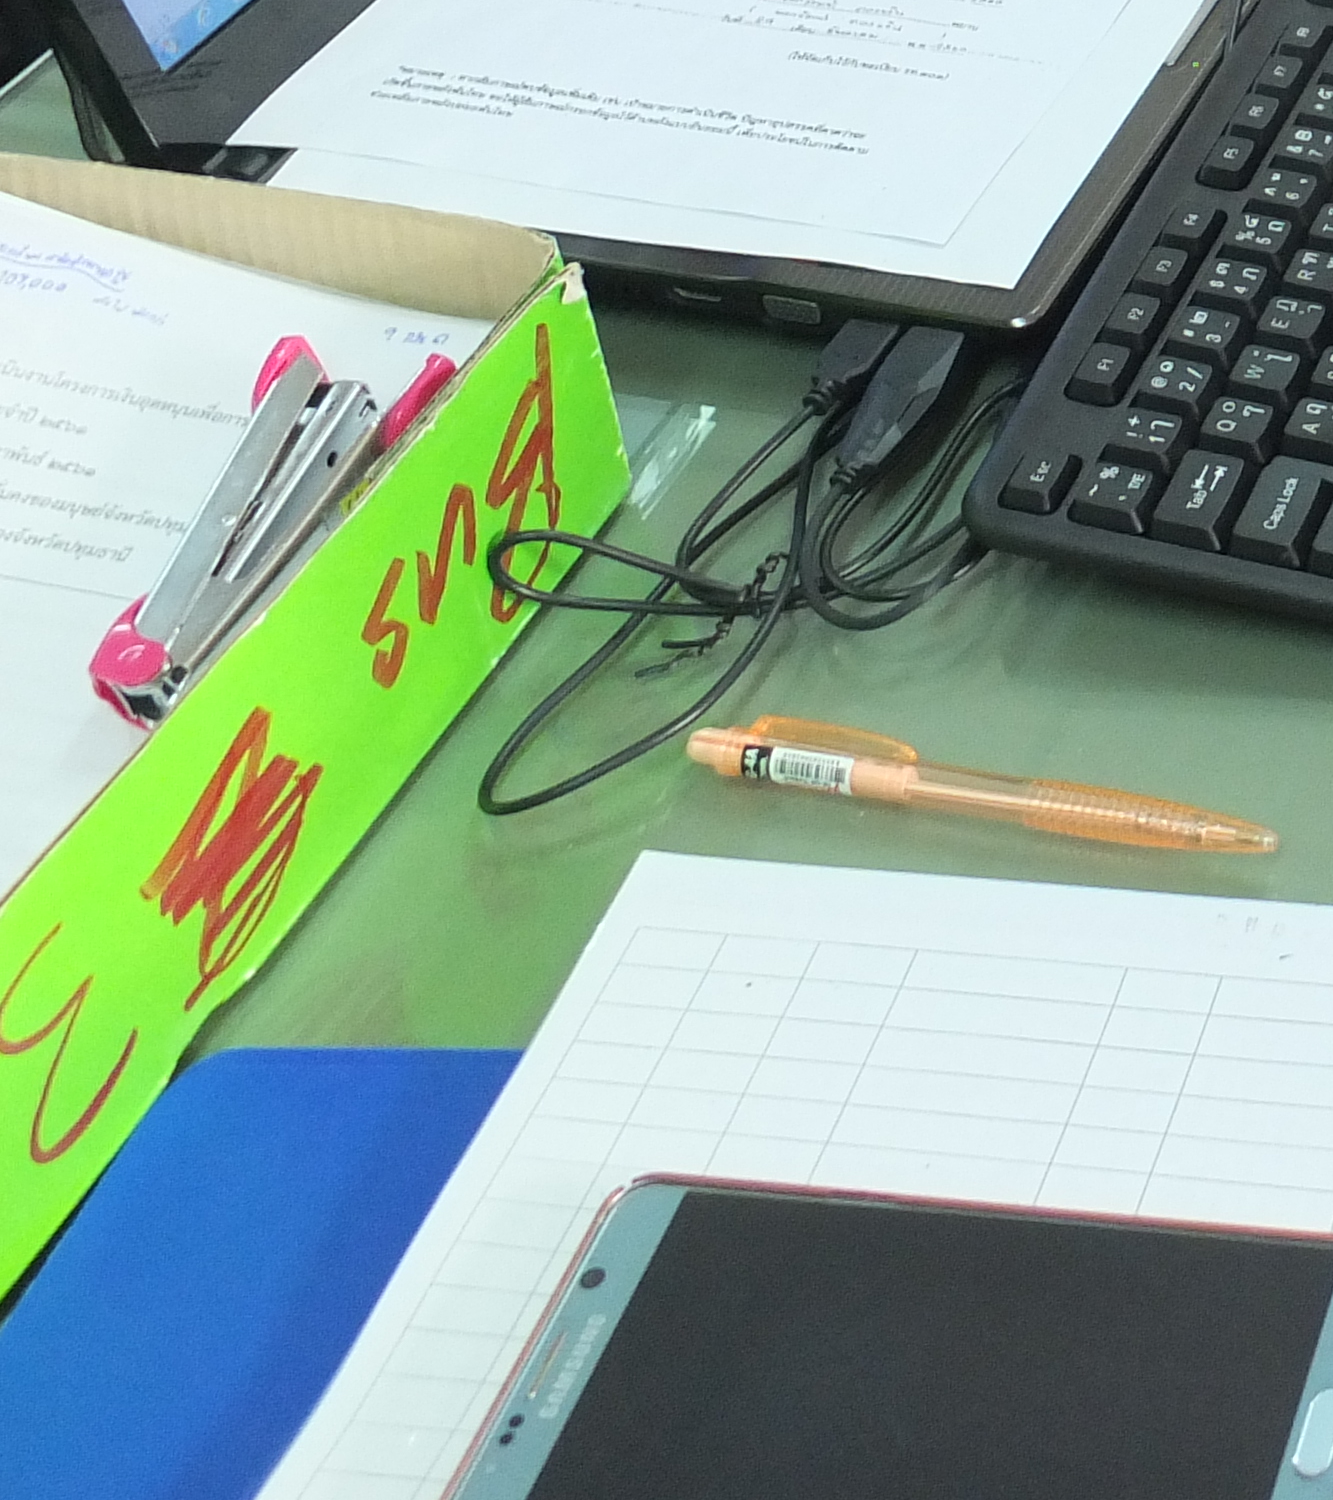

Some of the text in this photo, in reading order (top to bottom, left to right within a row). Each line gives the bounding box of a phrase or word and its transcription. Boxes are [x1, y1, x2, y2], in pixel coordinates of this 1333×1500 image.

[1244, 364, 1266, 381] W
[1029, 460, 1052, 483] Esc
[1186, 481, 1207, 510] Tab
[1280, 477, 1300, 505] Lock
[1263, 501, 1288, 530] Caps
[539, 1313, 607, 1419] SAMSUNG
